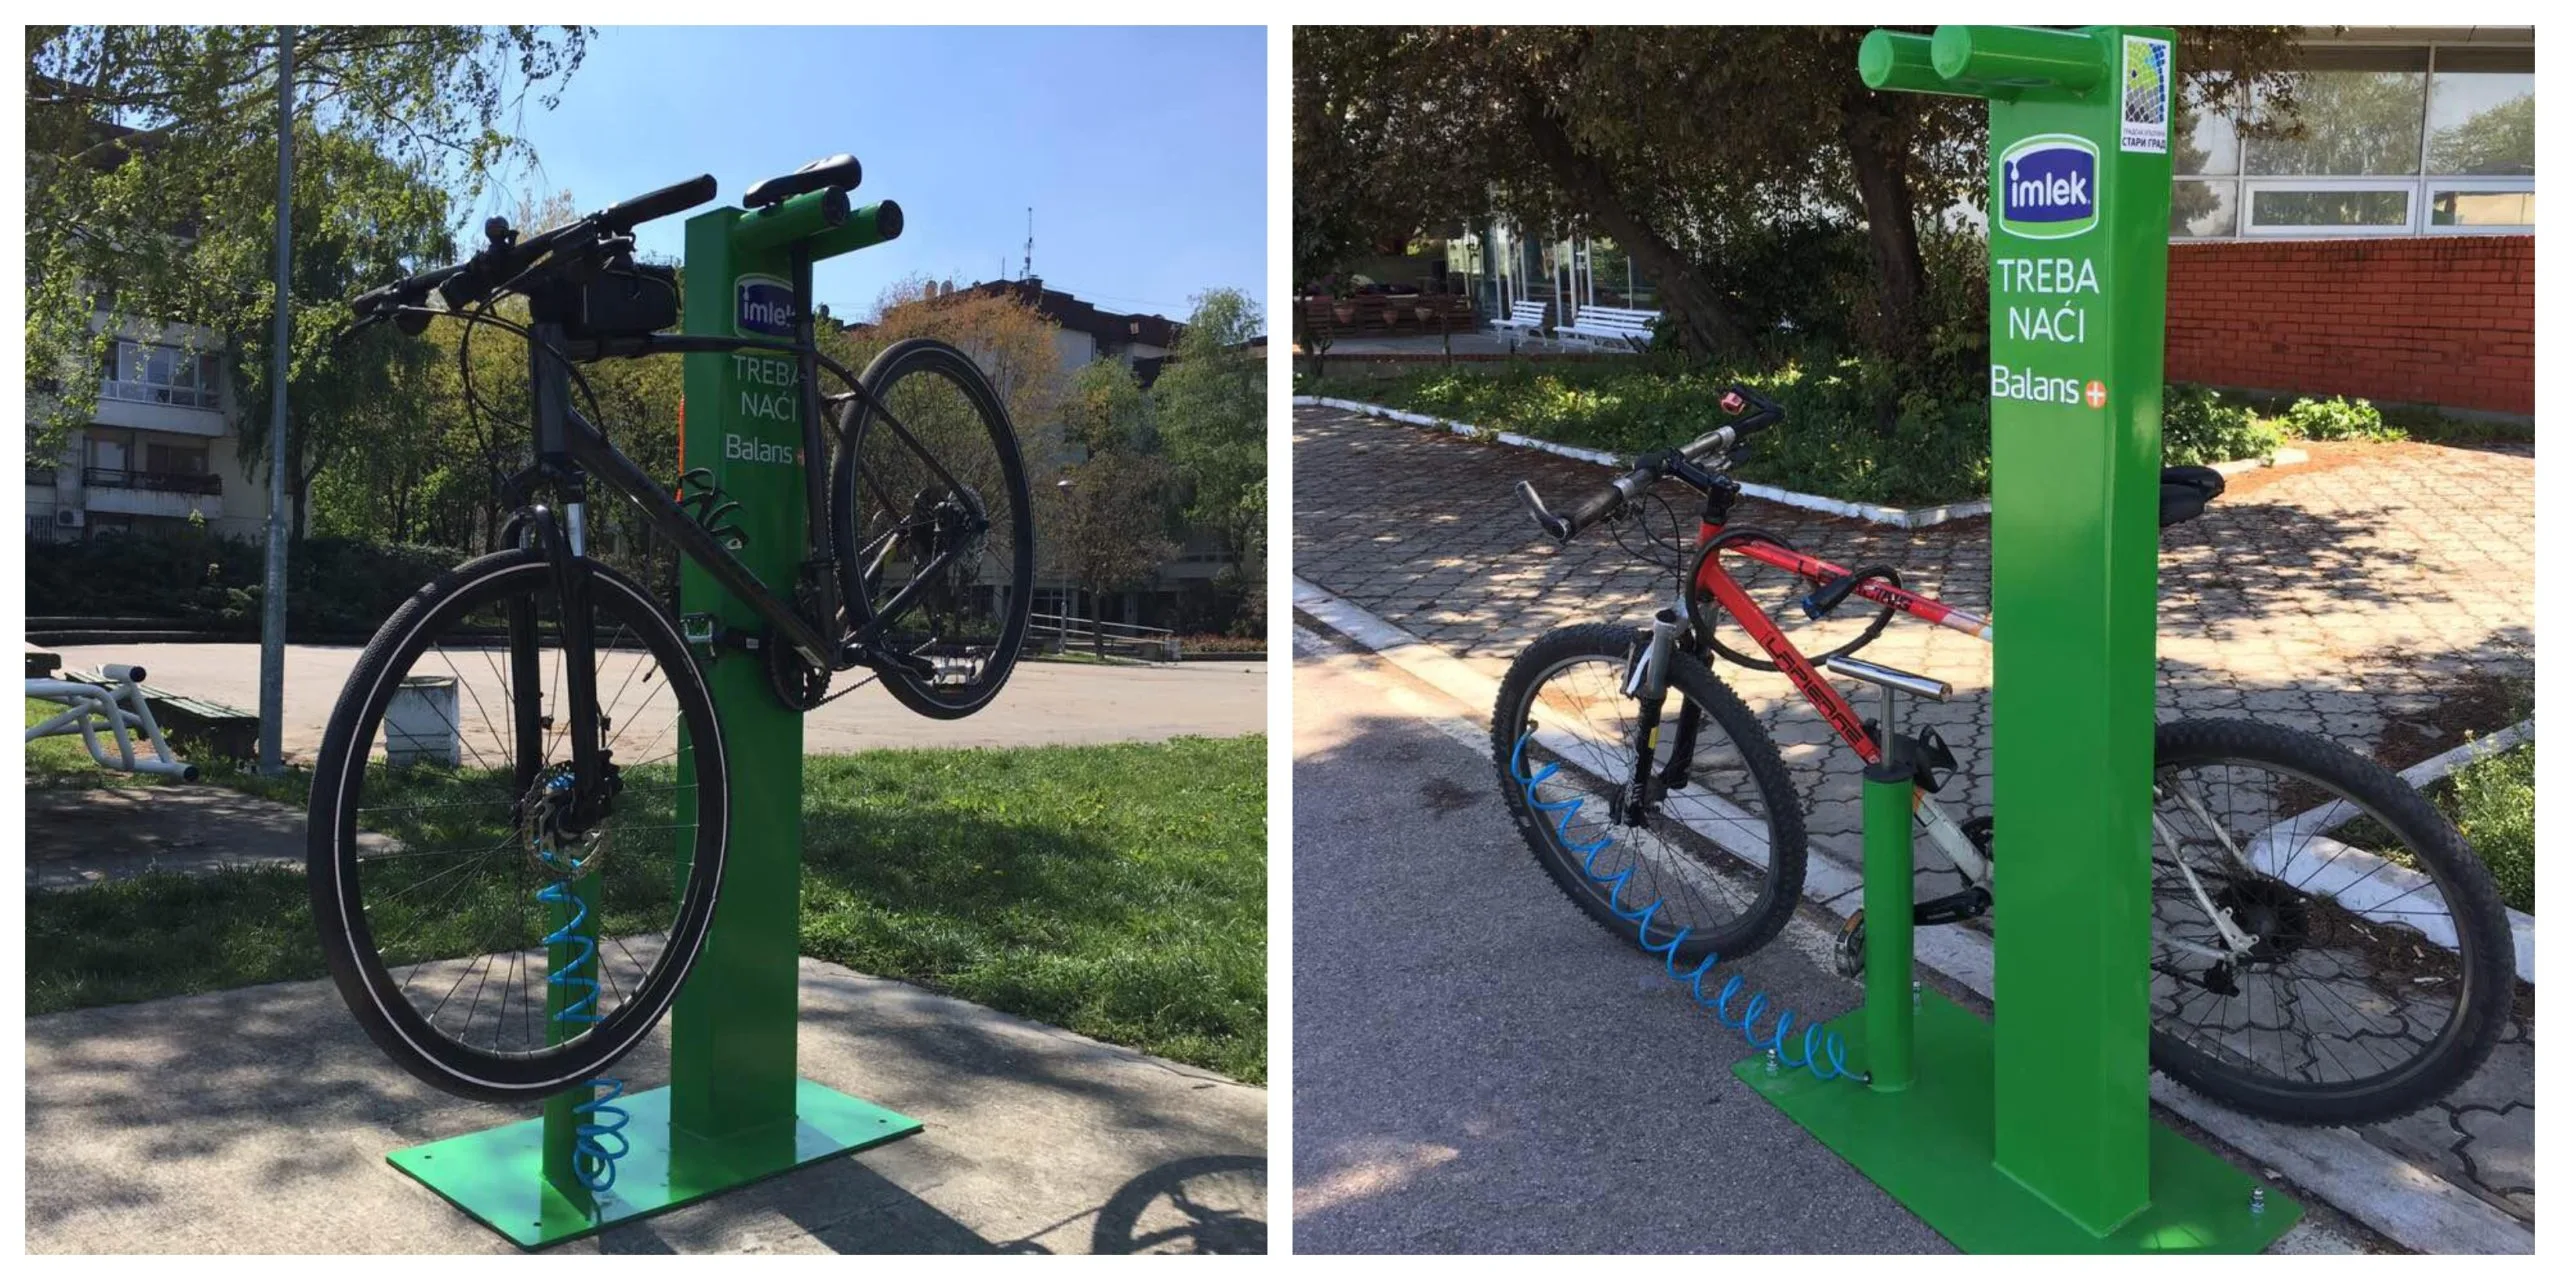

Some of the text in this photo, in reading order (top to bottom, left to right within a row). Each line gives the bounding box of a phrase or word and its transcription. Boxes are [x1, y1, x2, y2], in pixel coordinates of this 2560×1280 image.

[2122, 136, 2166, 150] СТАРИ ГРАД
[2010, 168, 2088, 208] imlek
[1997, 257, 2100, 294] TREBA
[2009, 301, 2084, 343] NAĆI
[1991, 364, 2080, 405] Balans
[740, 390, 797, 423] NAĆI
[726, 433, 793, 465] Balans
[1766, 634, 1864, 745] LAPIERRE
